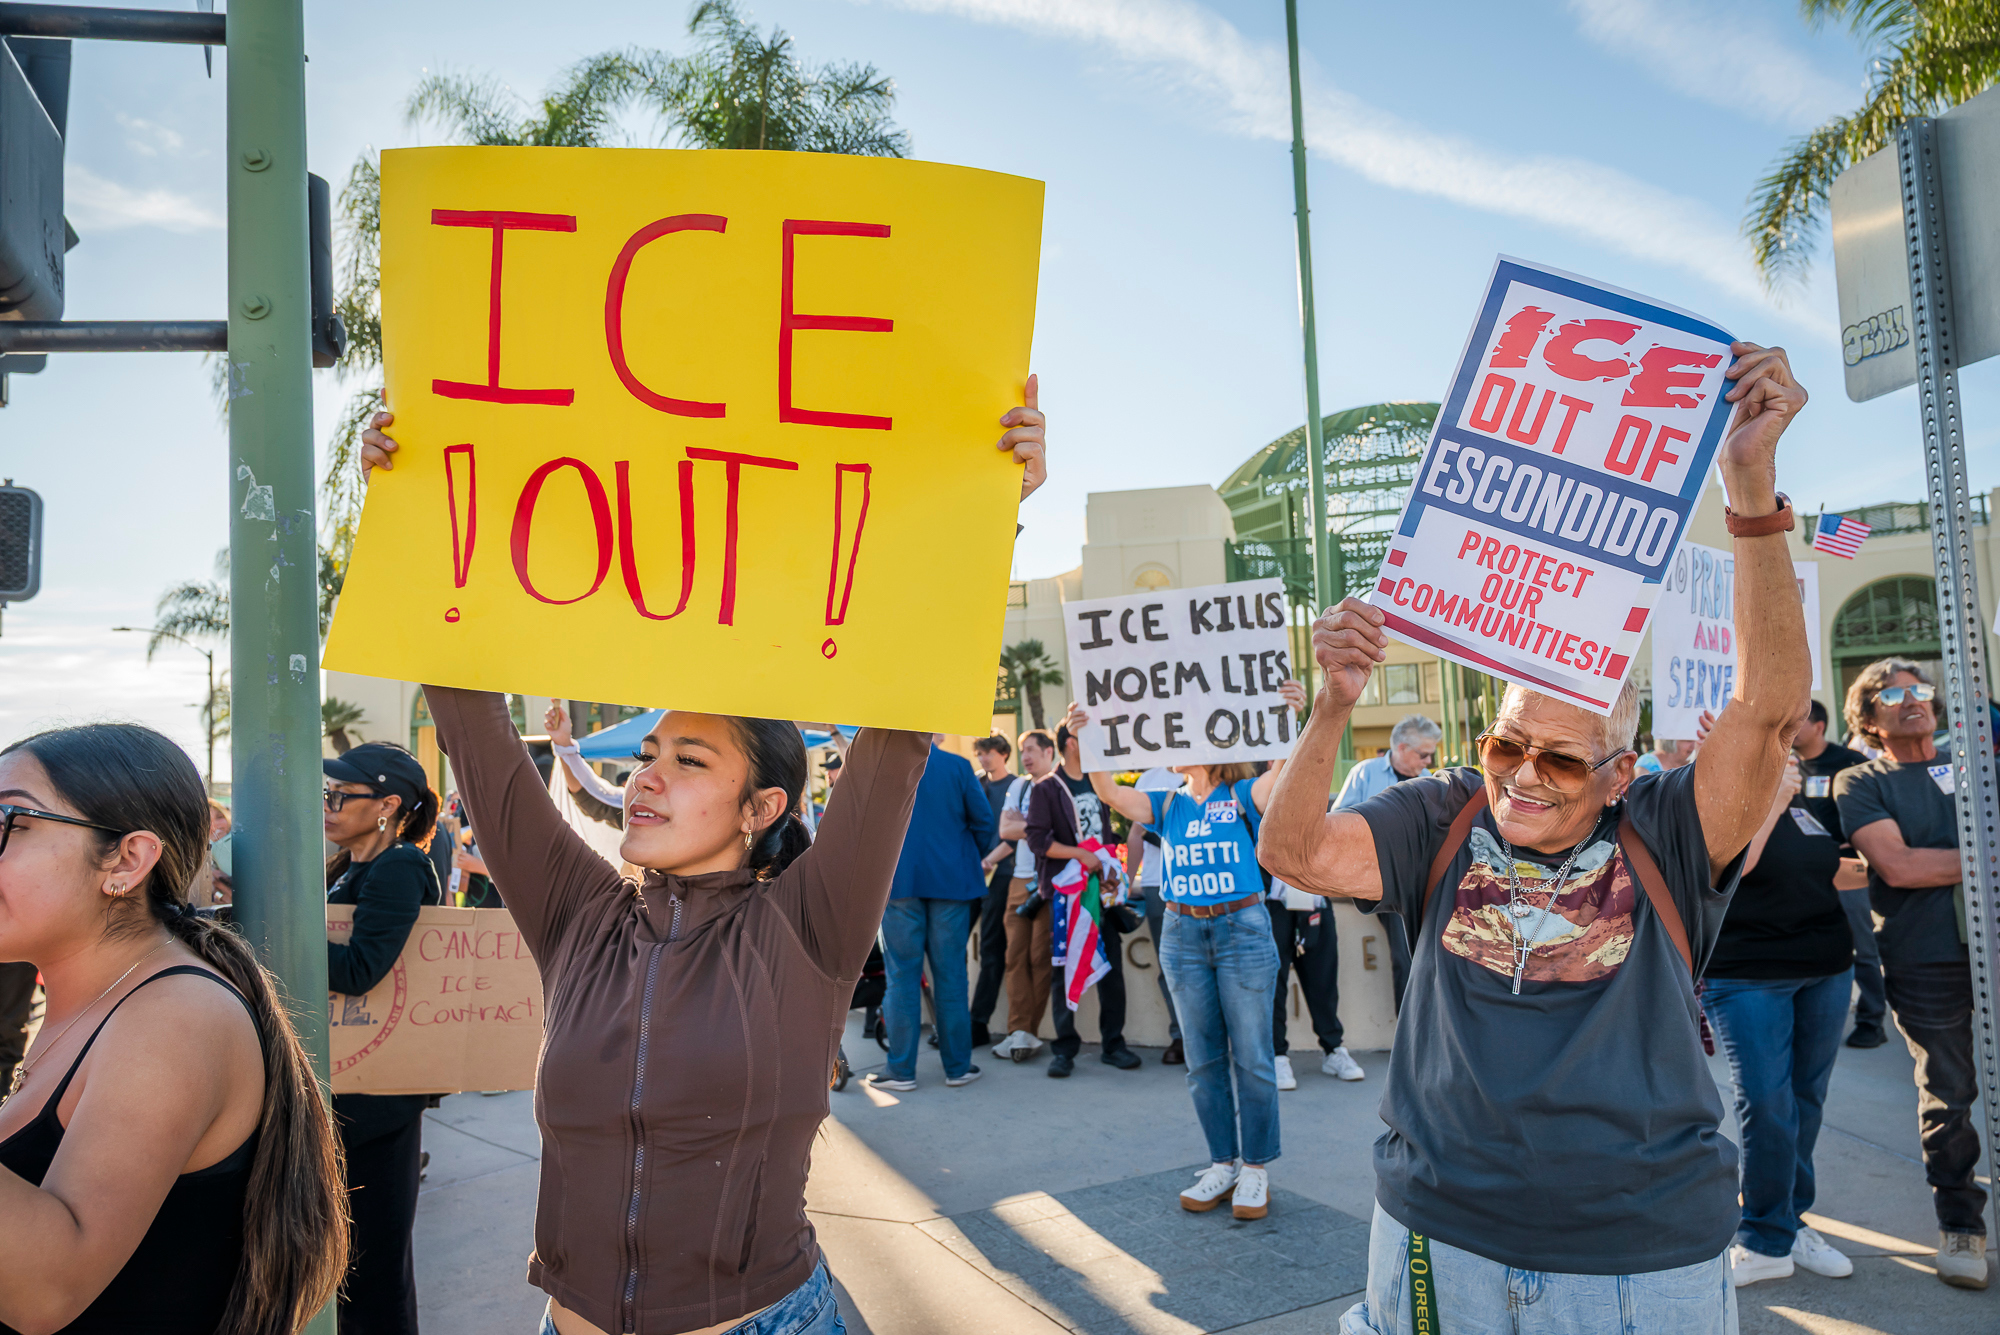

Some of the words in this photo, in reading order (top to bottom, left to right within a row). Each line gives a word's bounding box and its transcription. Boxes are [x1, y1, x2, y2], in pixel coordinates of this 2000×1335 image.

[431, 208, 894, 431] ICE
[1488, 305, 1723, 410] ICE
[1468, 372, 1594, 455] OUT
[1603, 413, 1692, 483] OF
[1421, 437, 1680, 568] ESCONDIDO
[1457, 529, 1594, 599] PROTECT
[1078, 603, 1169, 650] ICE
[1189, 592, 1285, 635] KILLS
[1479, 573, 1544, 619] OUR
[1394, 576, 1612, 677] COMMUNITIES!
[1693, 620, 1732, 655] AND
[1085, 661, 1211, 707] NOEM
[1221, 650, 1291, 696] LIES
[1667, 656, 1734, 711] SERVE
[1100, 712, 1191, 757] ICE
[1205, 704, 1290, 749] OUT
[1185, 819, 1212, 838] BE
[1172, 871, 1236, 897] GOOD
[419, 929, 533, 962] CANCEL
[439, 975, 492, 995] ICE
